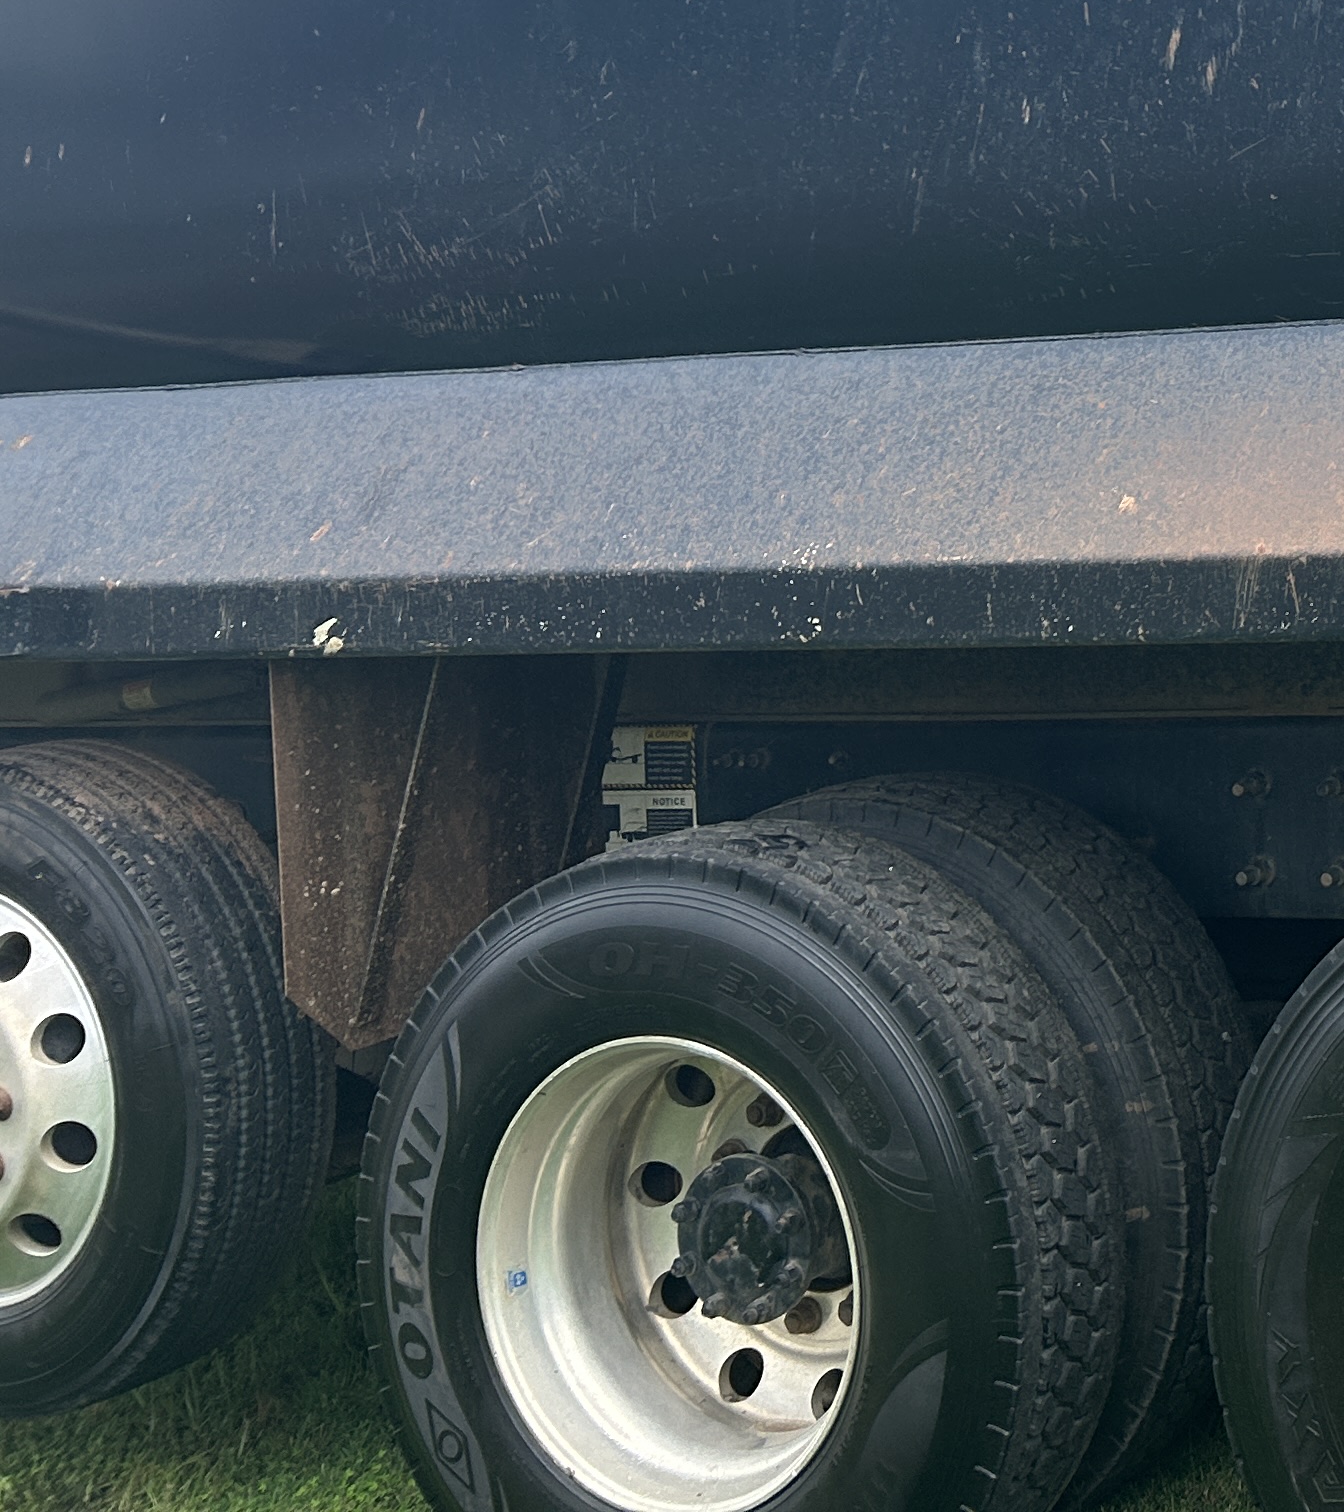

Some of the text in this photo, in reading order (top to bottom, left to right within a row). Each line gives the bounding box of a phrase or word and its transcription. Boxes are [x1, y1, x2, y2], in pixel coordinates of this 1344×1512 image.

[655, 729, 688, 738] CAUTION
[652, 797, 686, 806] NOTICE
[389, 1106, 442, 1381] OTANI
